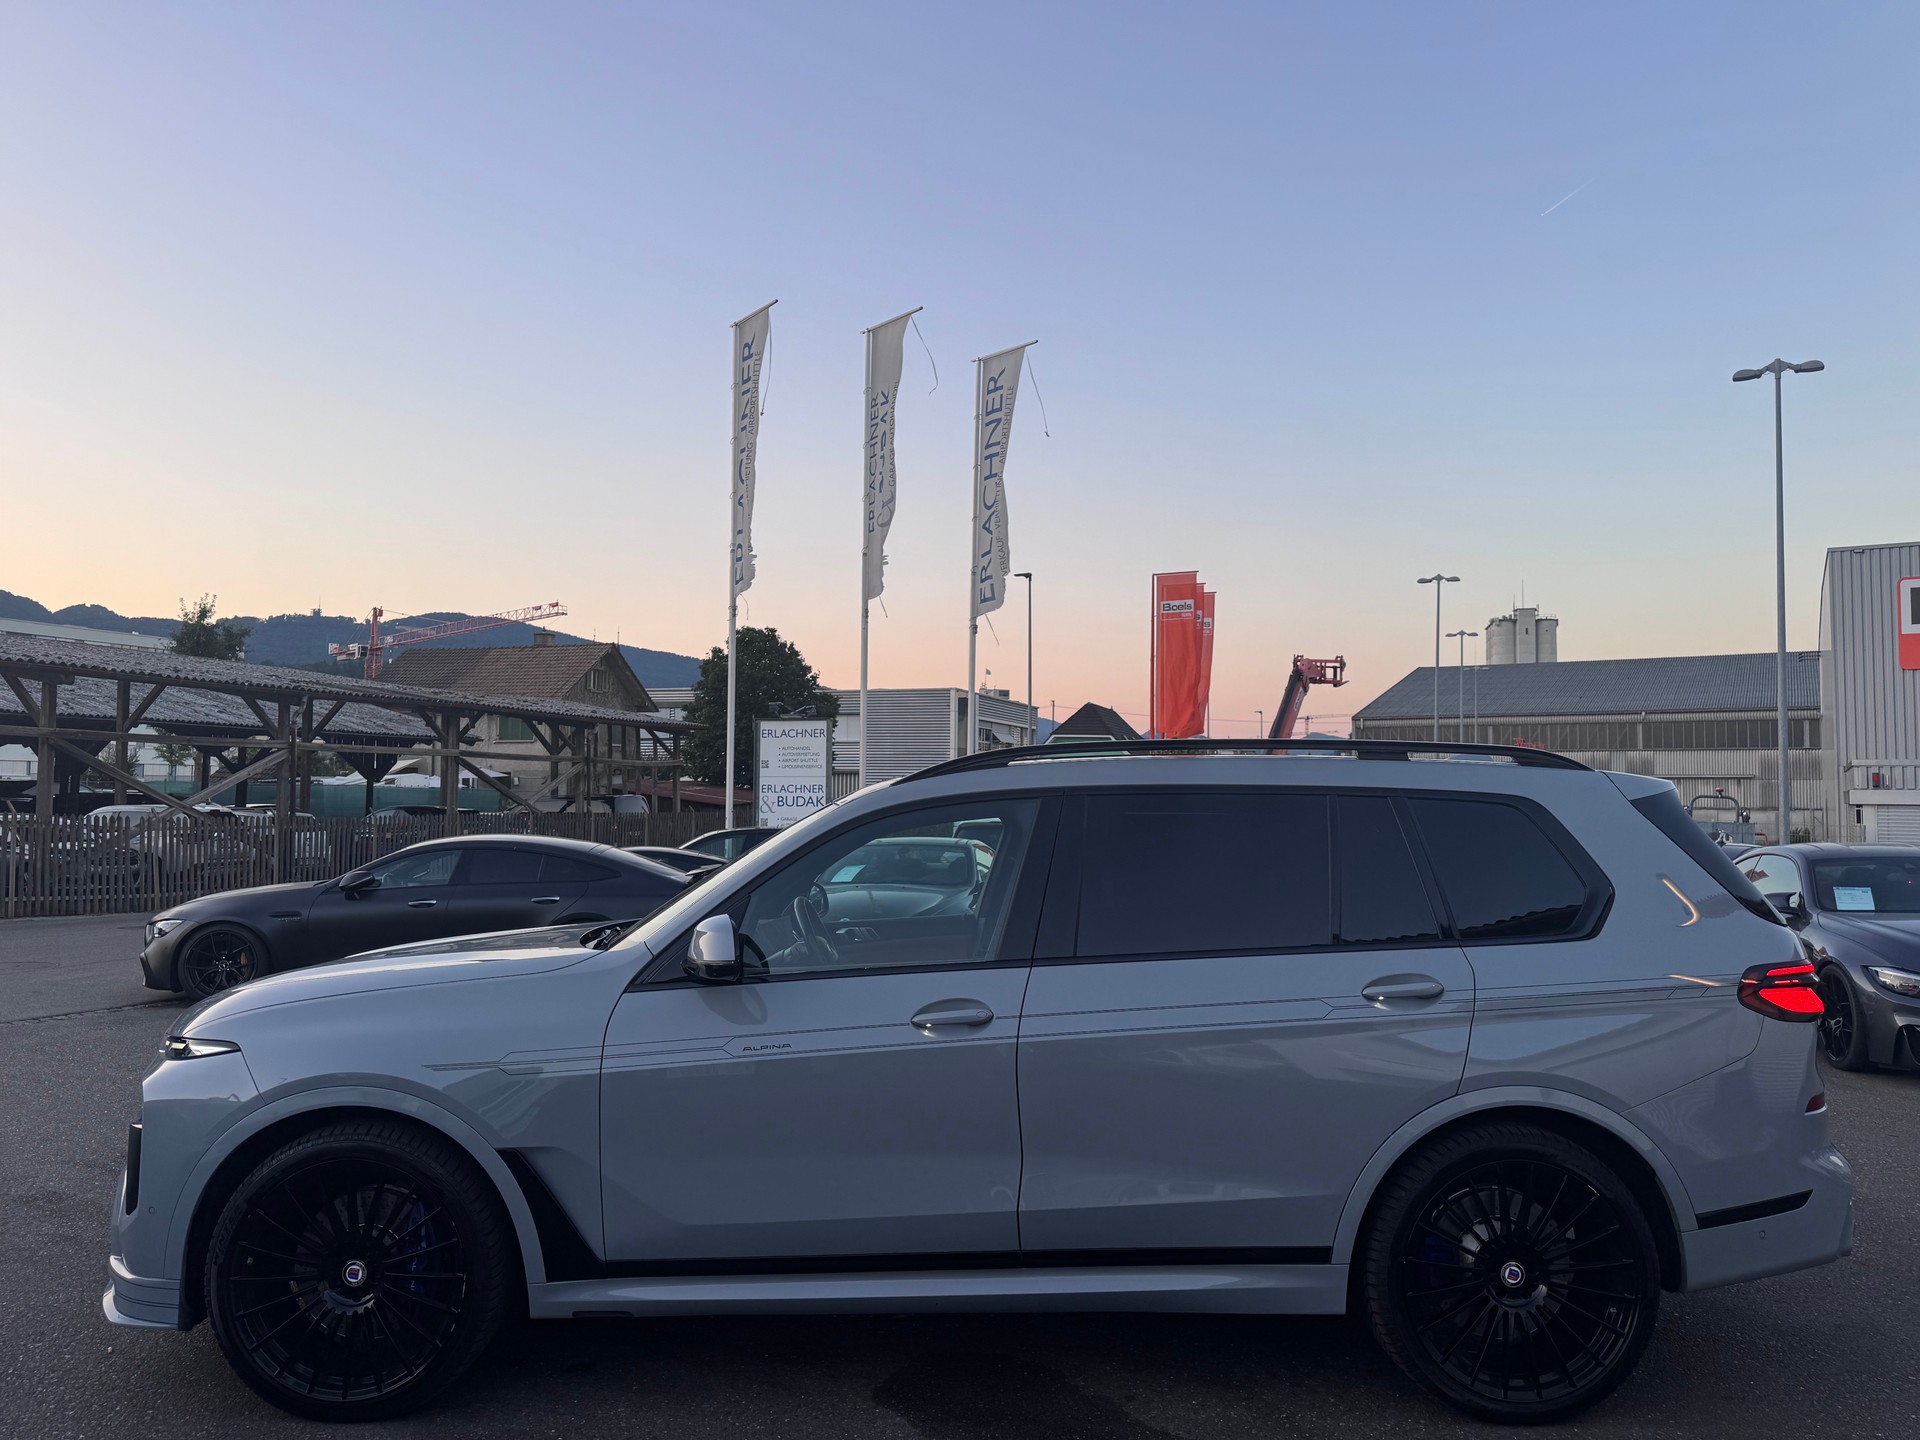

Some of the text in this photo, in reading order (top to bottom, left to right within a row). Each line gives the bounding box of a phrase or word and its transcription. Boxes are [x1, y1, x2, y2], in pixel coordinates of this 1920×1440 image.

[999, 385, 1015, 464] AIRPORTSHUTTLE
[980, 367, 1006, 604] ERLACHNER
[1162, 602, 1193, 612] Boels
[761, 728, 826, 739] ERLACHNER
[761, 784, 824, 794] ERLACHNER
[760, 795, 825, 814] & BUDAK
[742, 1043, 792, 1052] ALPINA
